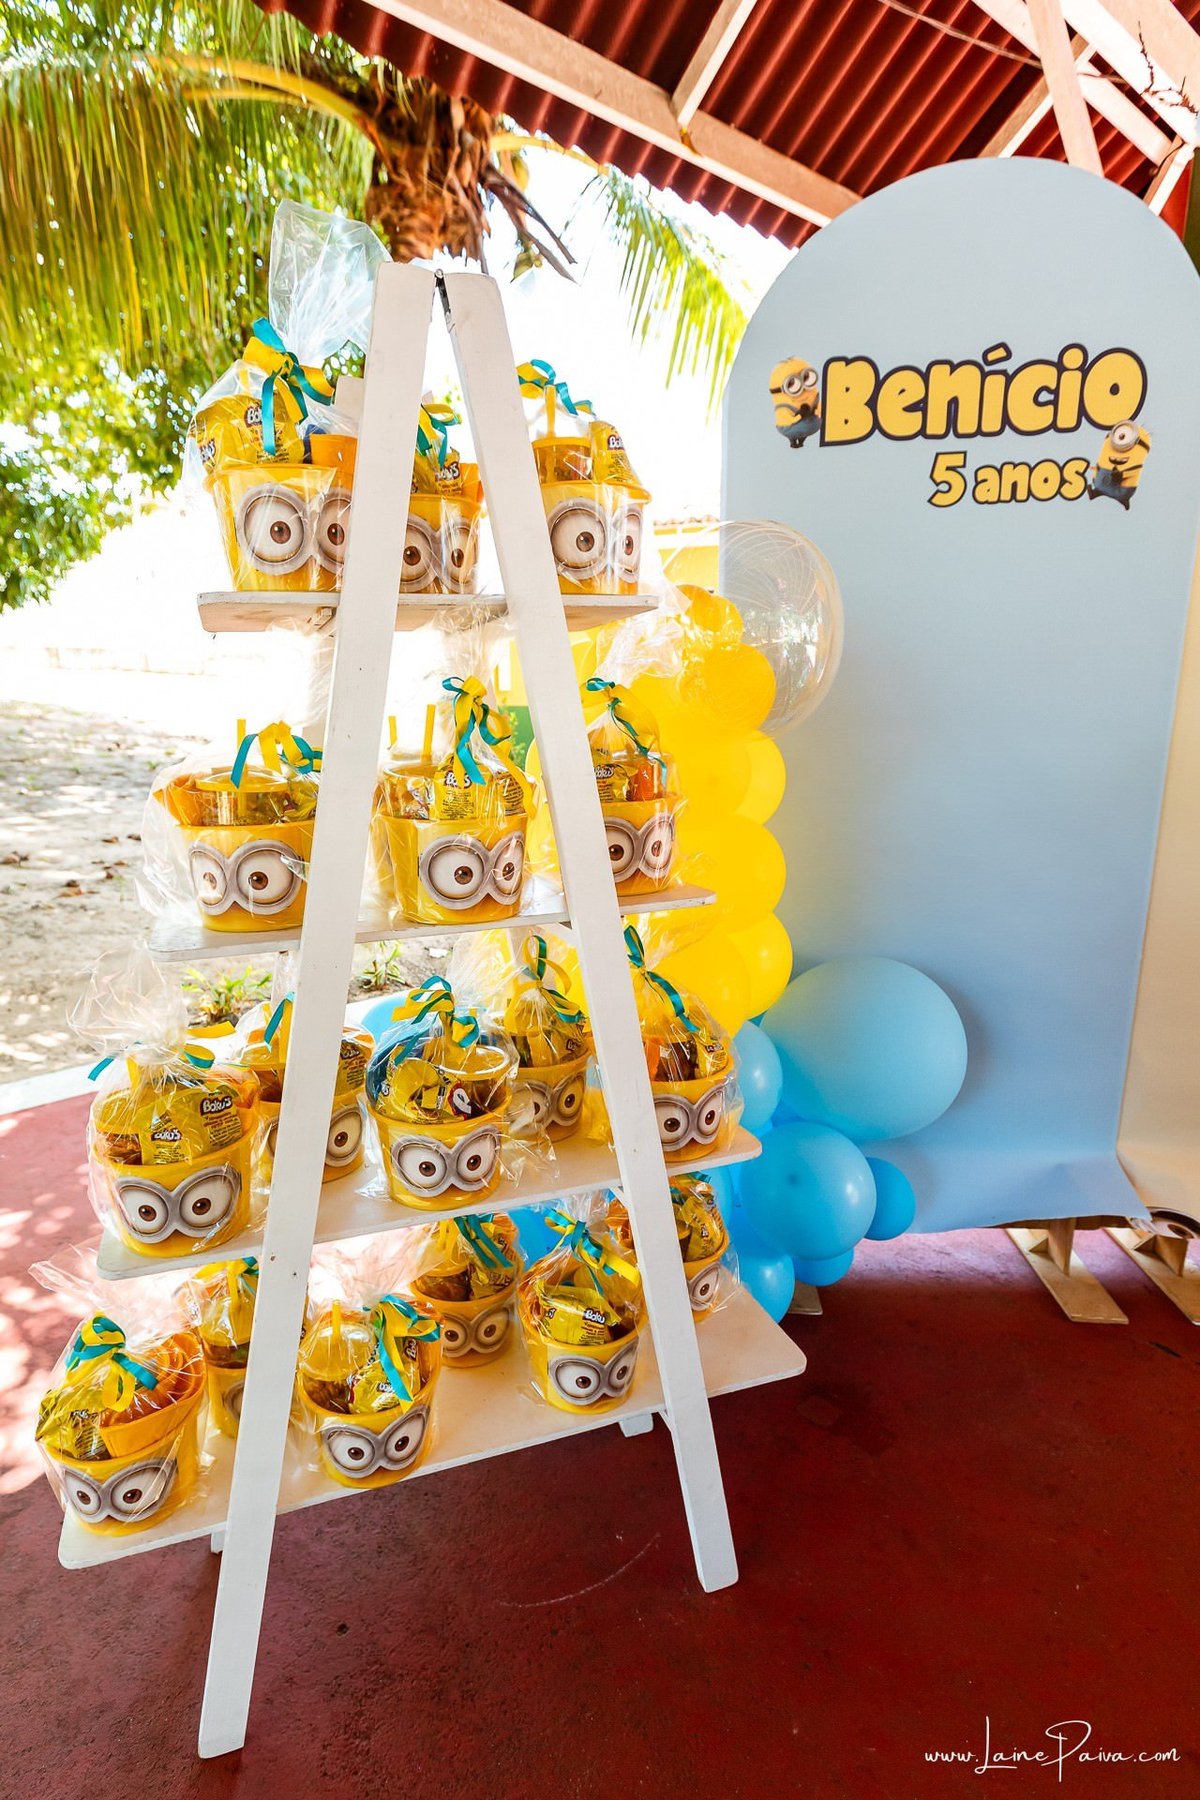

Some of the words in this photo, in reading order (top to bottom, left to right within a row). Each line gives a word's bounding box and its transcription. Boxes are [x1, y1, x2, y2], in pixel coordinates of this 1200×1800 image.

[819, 342, 1148, 447] Benício
[927, 450, 967, 508] 5
[972, 457, 1090, 505] anos
